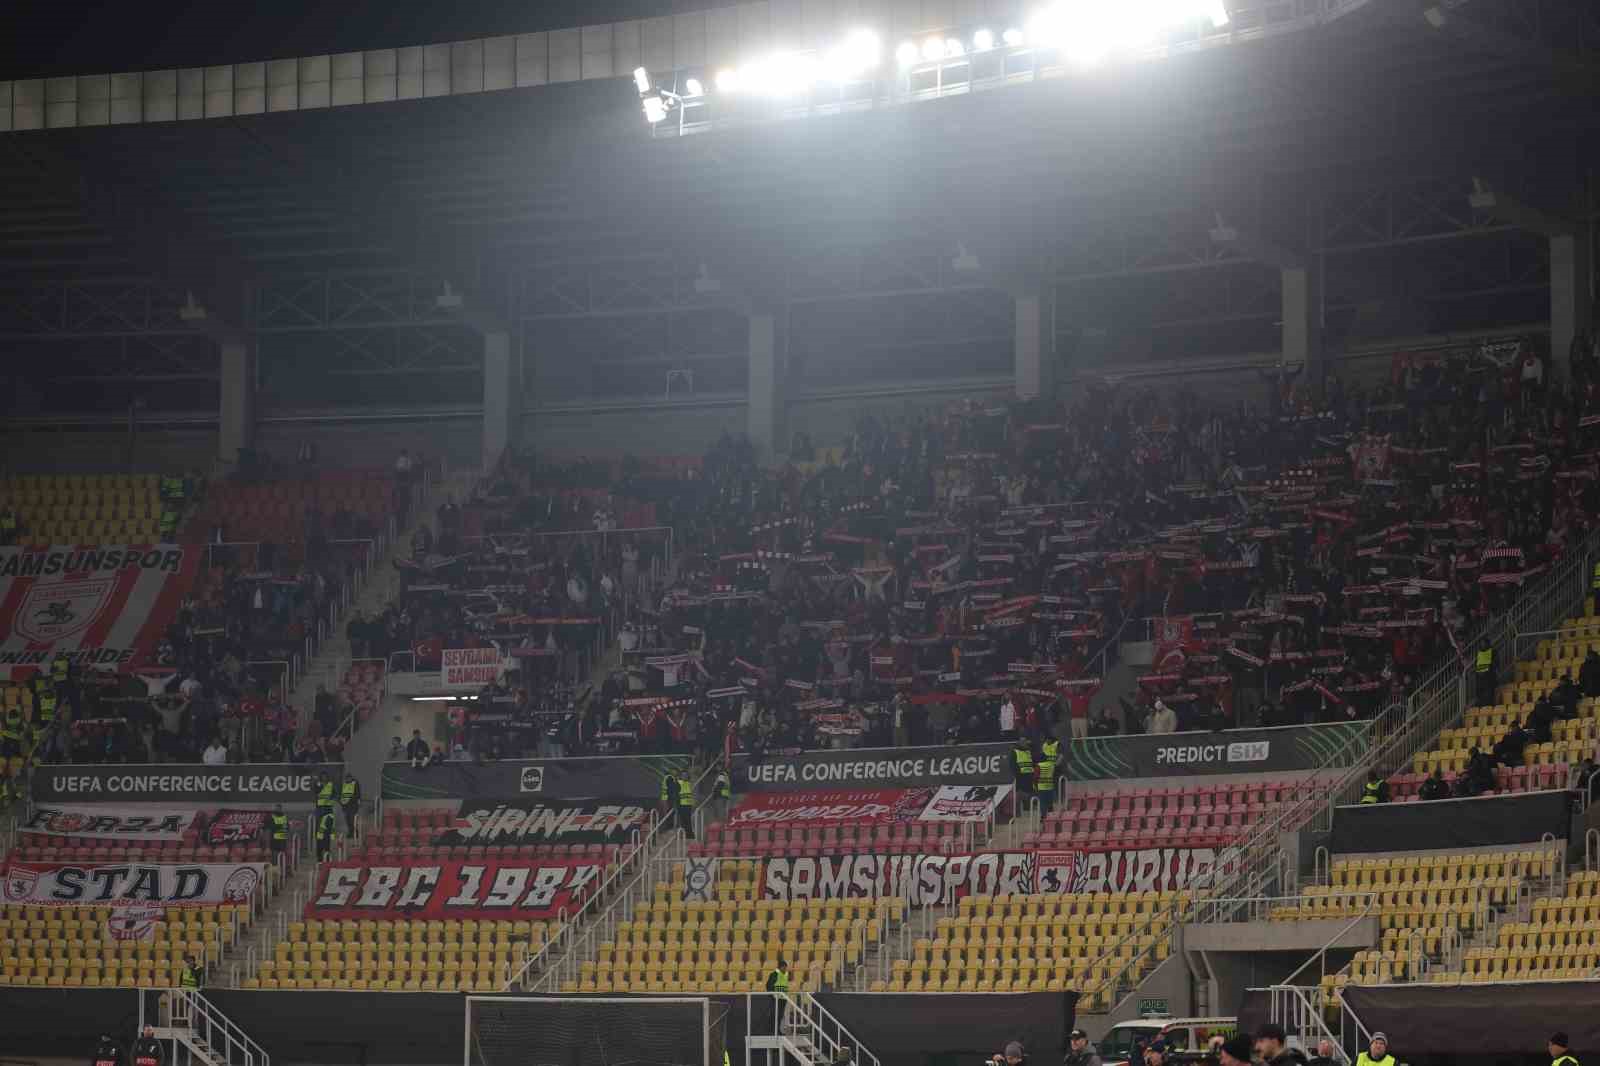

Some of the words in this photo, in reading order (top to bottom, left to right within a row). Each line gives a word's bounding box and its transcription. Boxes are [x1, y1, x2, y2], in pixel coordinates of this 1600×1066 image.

[749, 765, 797, 783] UEFA
[802, 759, 924, 781] CONFERENCE
[930, 755, 1001, 776] LEAGUE
[1156, 745, 1226, 764] PREDICT
[52, 776, 101, 793] UEFA
[107, 775, 232, 792] CONFERENCE
[238, 775, 312, 792] LEAGUE
[52, 866, 209, 901] STAD
[315, 865, 441, 907] SBC
[445, 863, 601, 907] 1984
[764, 853, 1022, 907] SAMSUNSPOR
